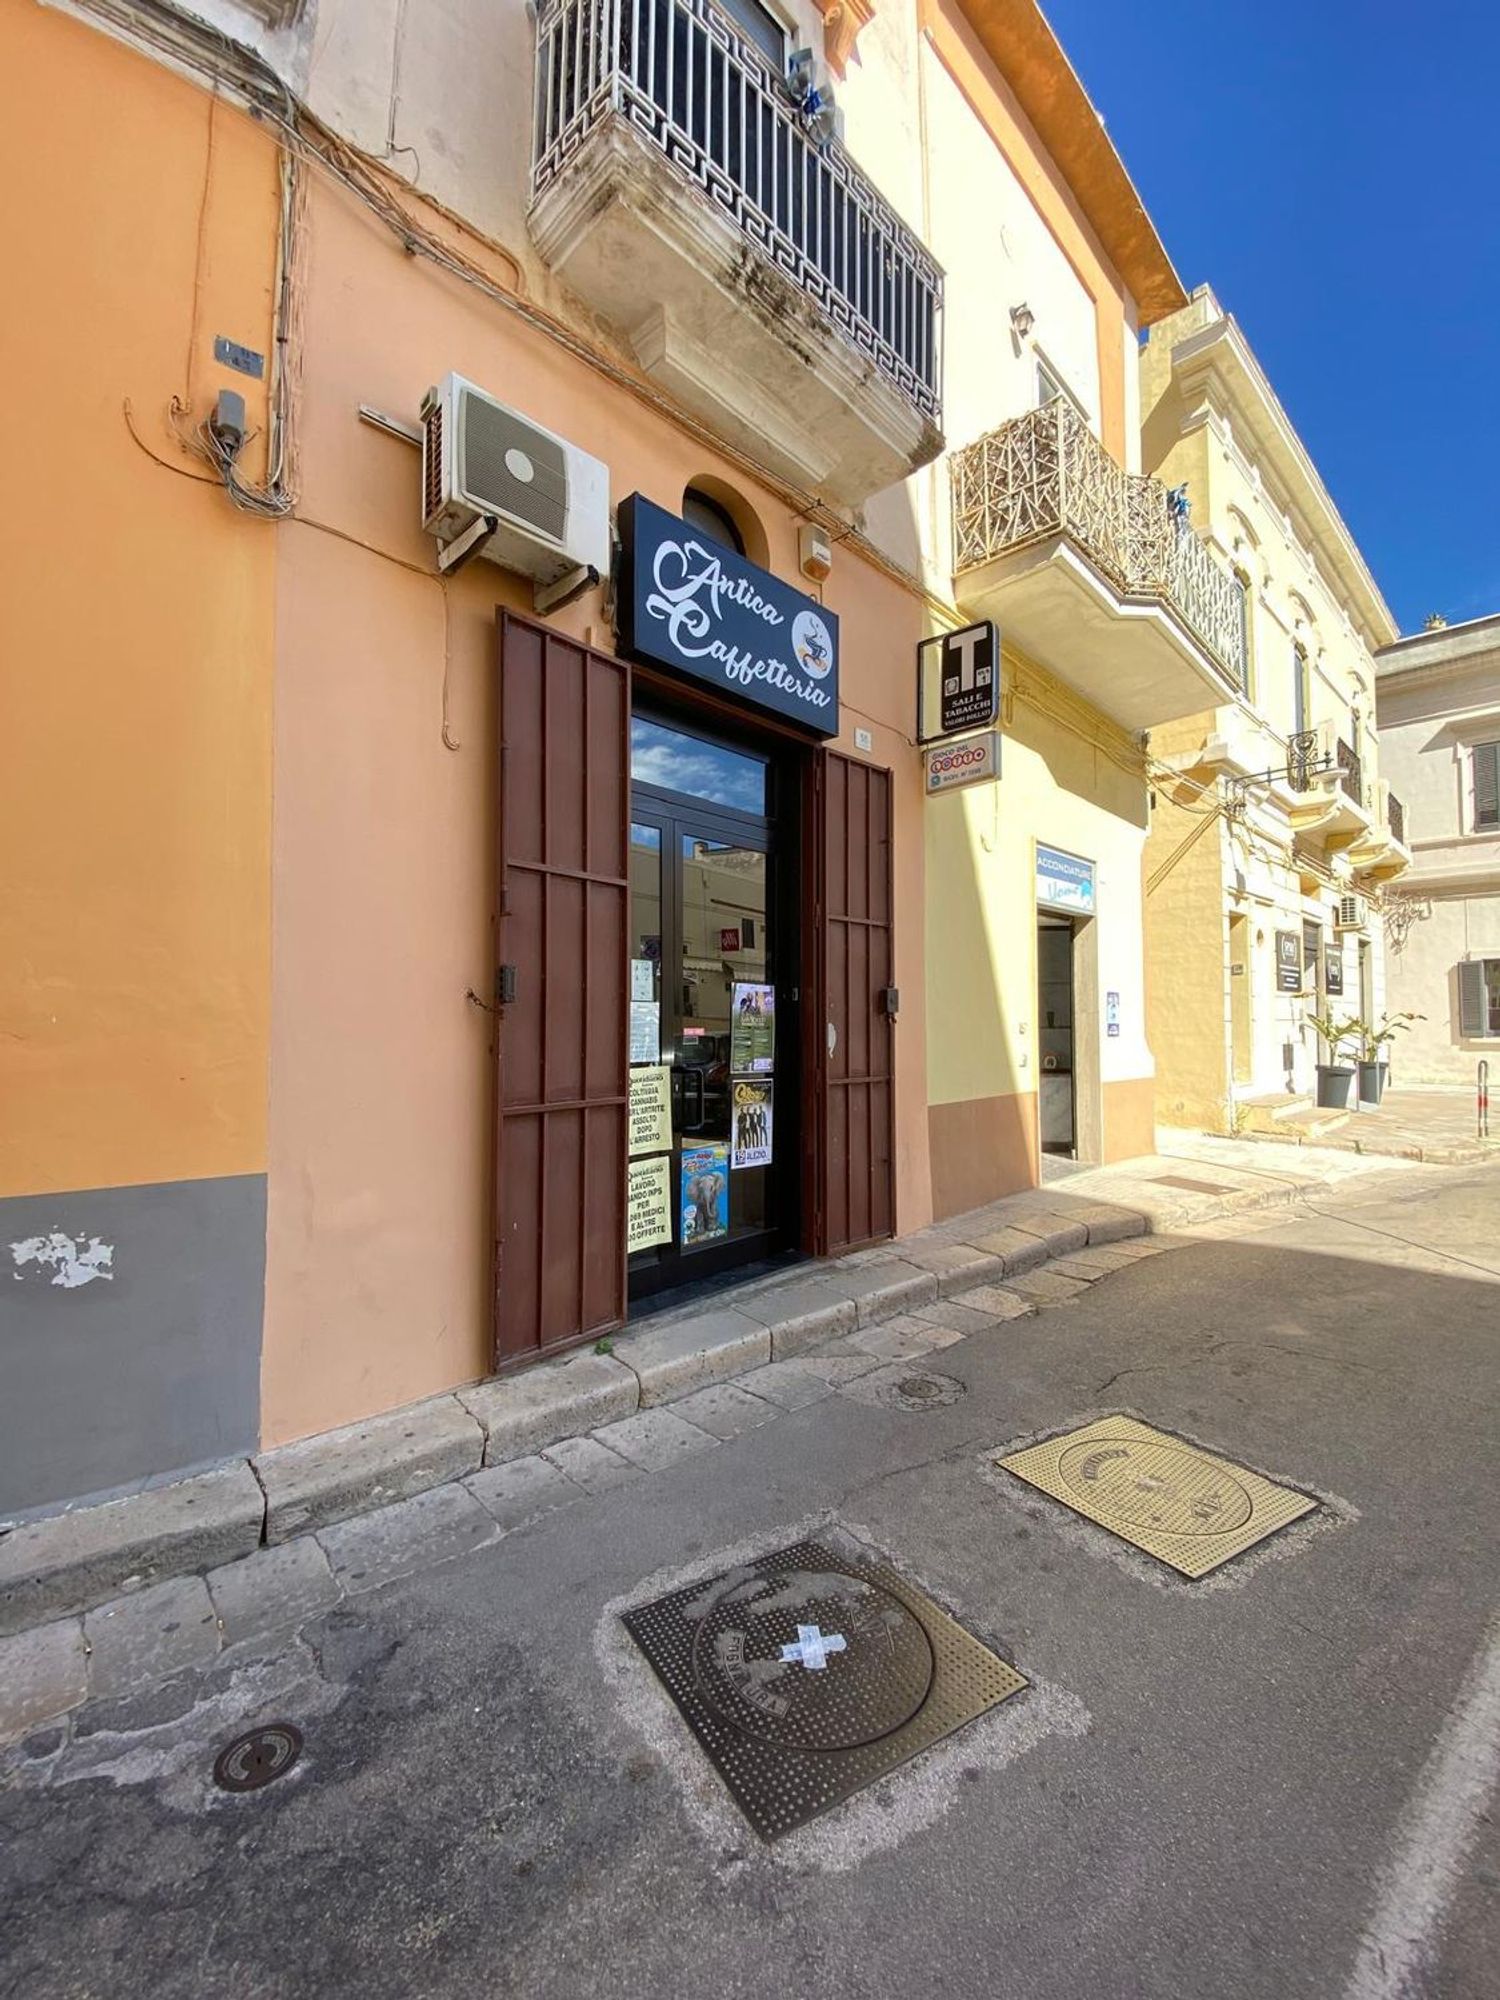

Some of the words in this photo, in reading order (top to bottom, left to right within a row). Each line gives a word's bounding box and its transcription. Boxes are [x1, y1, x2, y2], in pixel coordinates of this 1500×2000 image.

[653, 540, 784, 626] Antica
[645, 594, 831, 708] Caffetteria
[949, 626, 988, 692] T
[952, 694, 974, 708] SALI
[945, 699, 991, 718] TABACCHI
[632, 1115, 657, 1125] ASSOLTO
[637, 1125, 652, 1134] DOPO
[631, 1179, 656, 1192] LAVORO
[637, 1200, 650, 1210] PER
